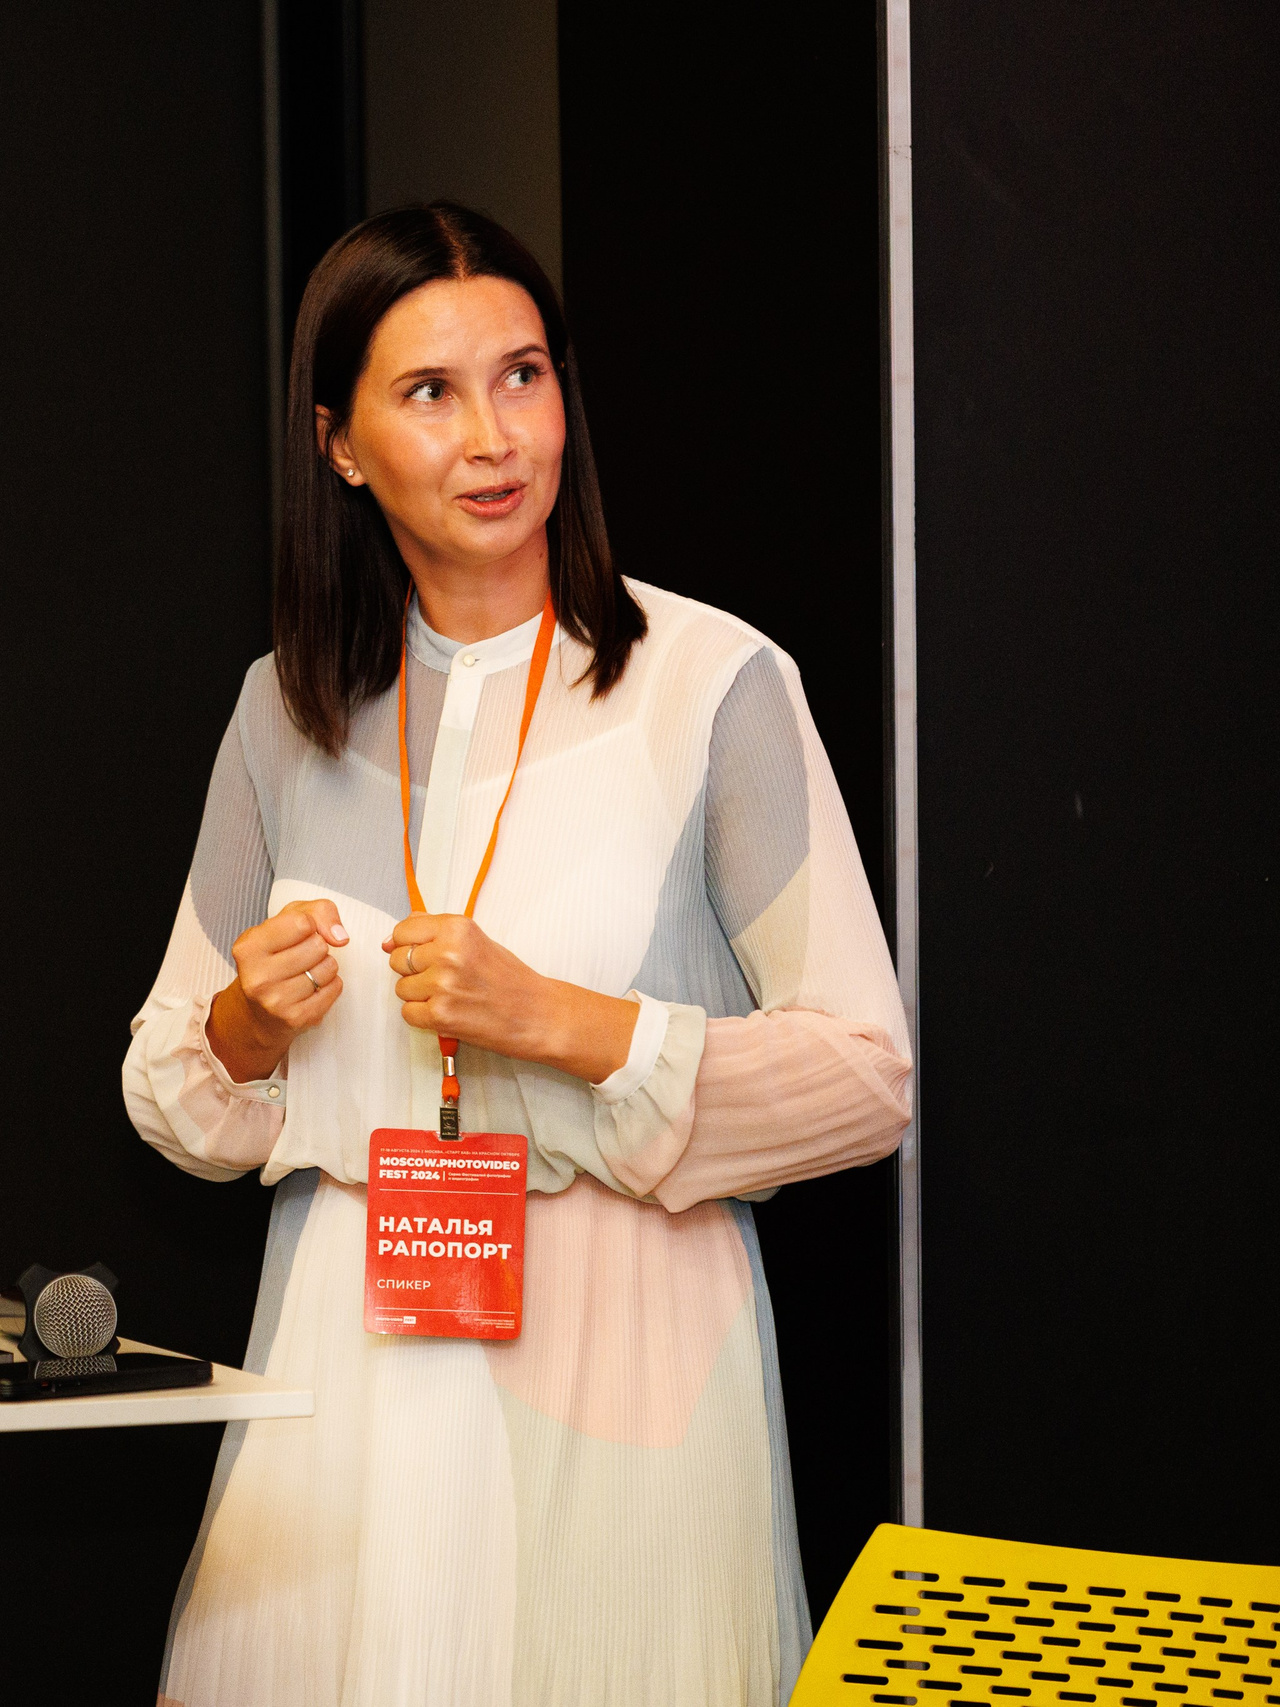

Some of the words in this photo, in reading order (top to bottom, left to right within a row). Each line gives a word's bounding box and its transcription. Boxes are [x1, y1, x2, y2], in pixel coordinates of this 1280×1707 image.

[379, 1156, 520, 1171] MOSCOW.PHOTOVIDEO
[379, 1169, 408, 1180] FEST
[410, 1170, 440, 1180] 2024
[378, 1216, 493, 1236] НАТАЛЬЯ
[378, 1239, 512, 1260] РАПОПОРТ
[376, 1279, 431, 1290] СПИКЕР
